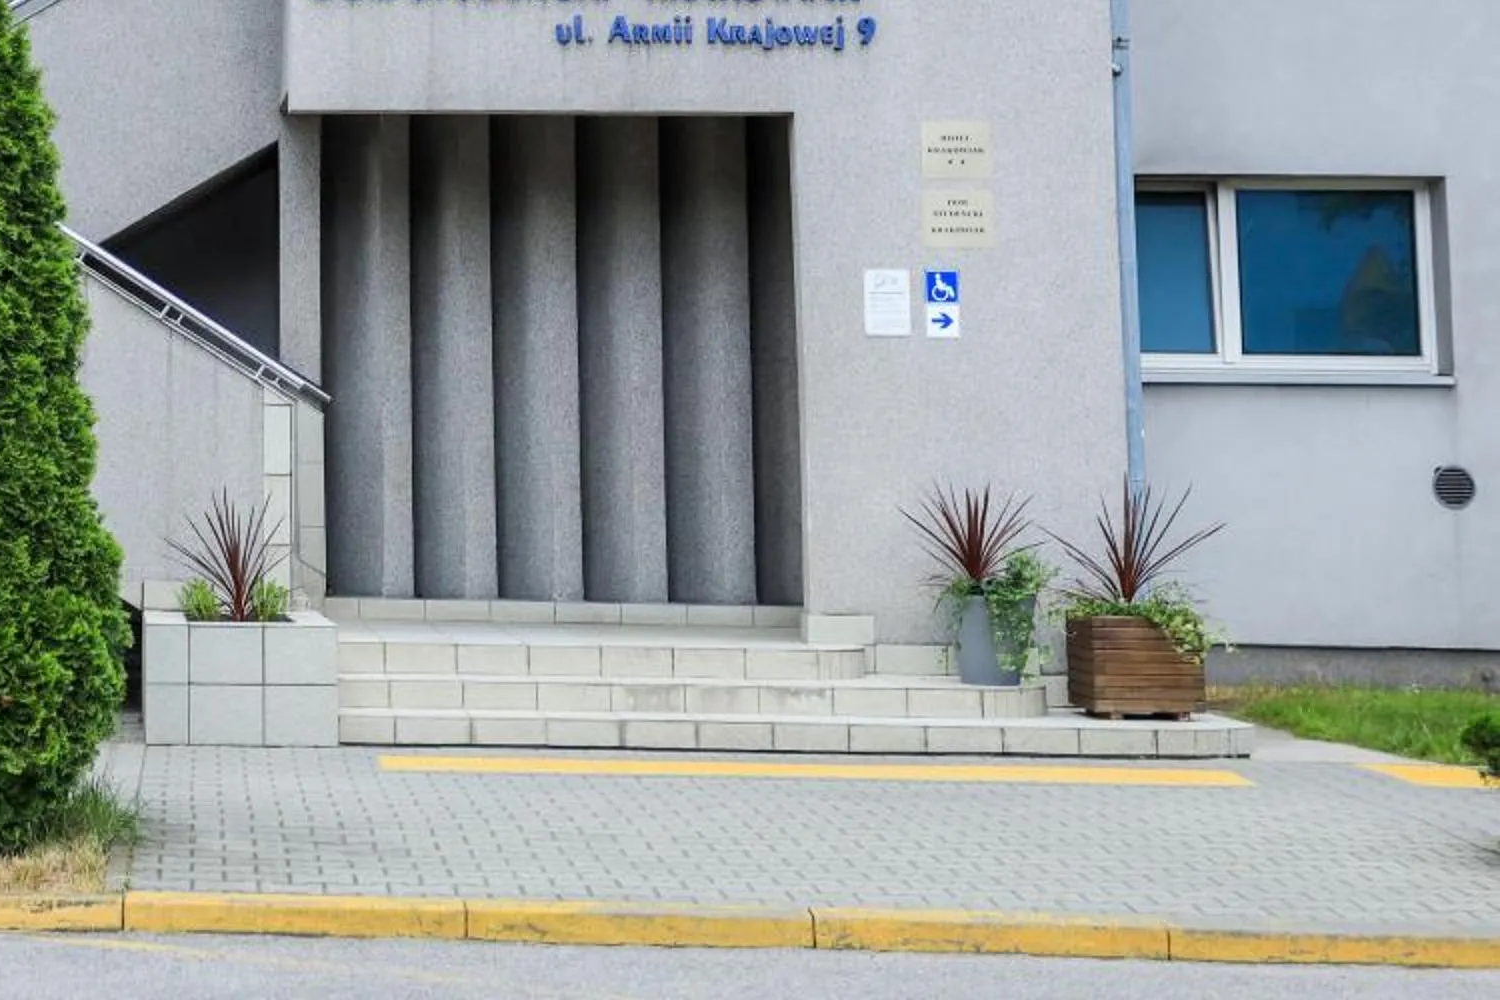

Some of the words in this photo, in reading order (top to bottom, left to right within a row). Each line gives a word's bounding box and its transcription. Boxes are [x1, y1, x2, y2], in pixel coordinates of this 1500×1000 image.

[556, 17, 594, 46] ul.
[608, 17, 695, 45] Armii
[707, 17, 846, 51] Krajowej
[857, 17, 877, 45] 9
